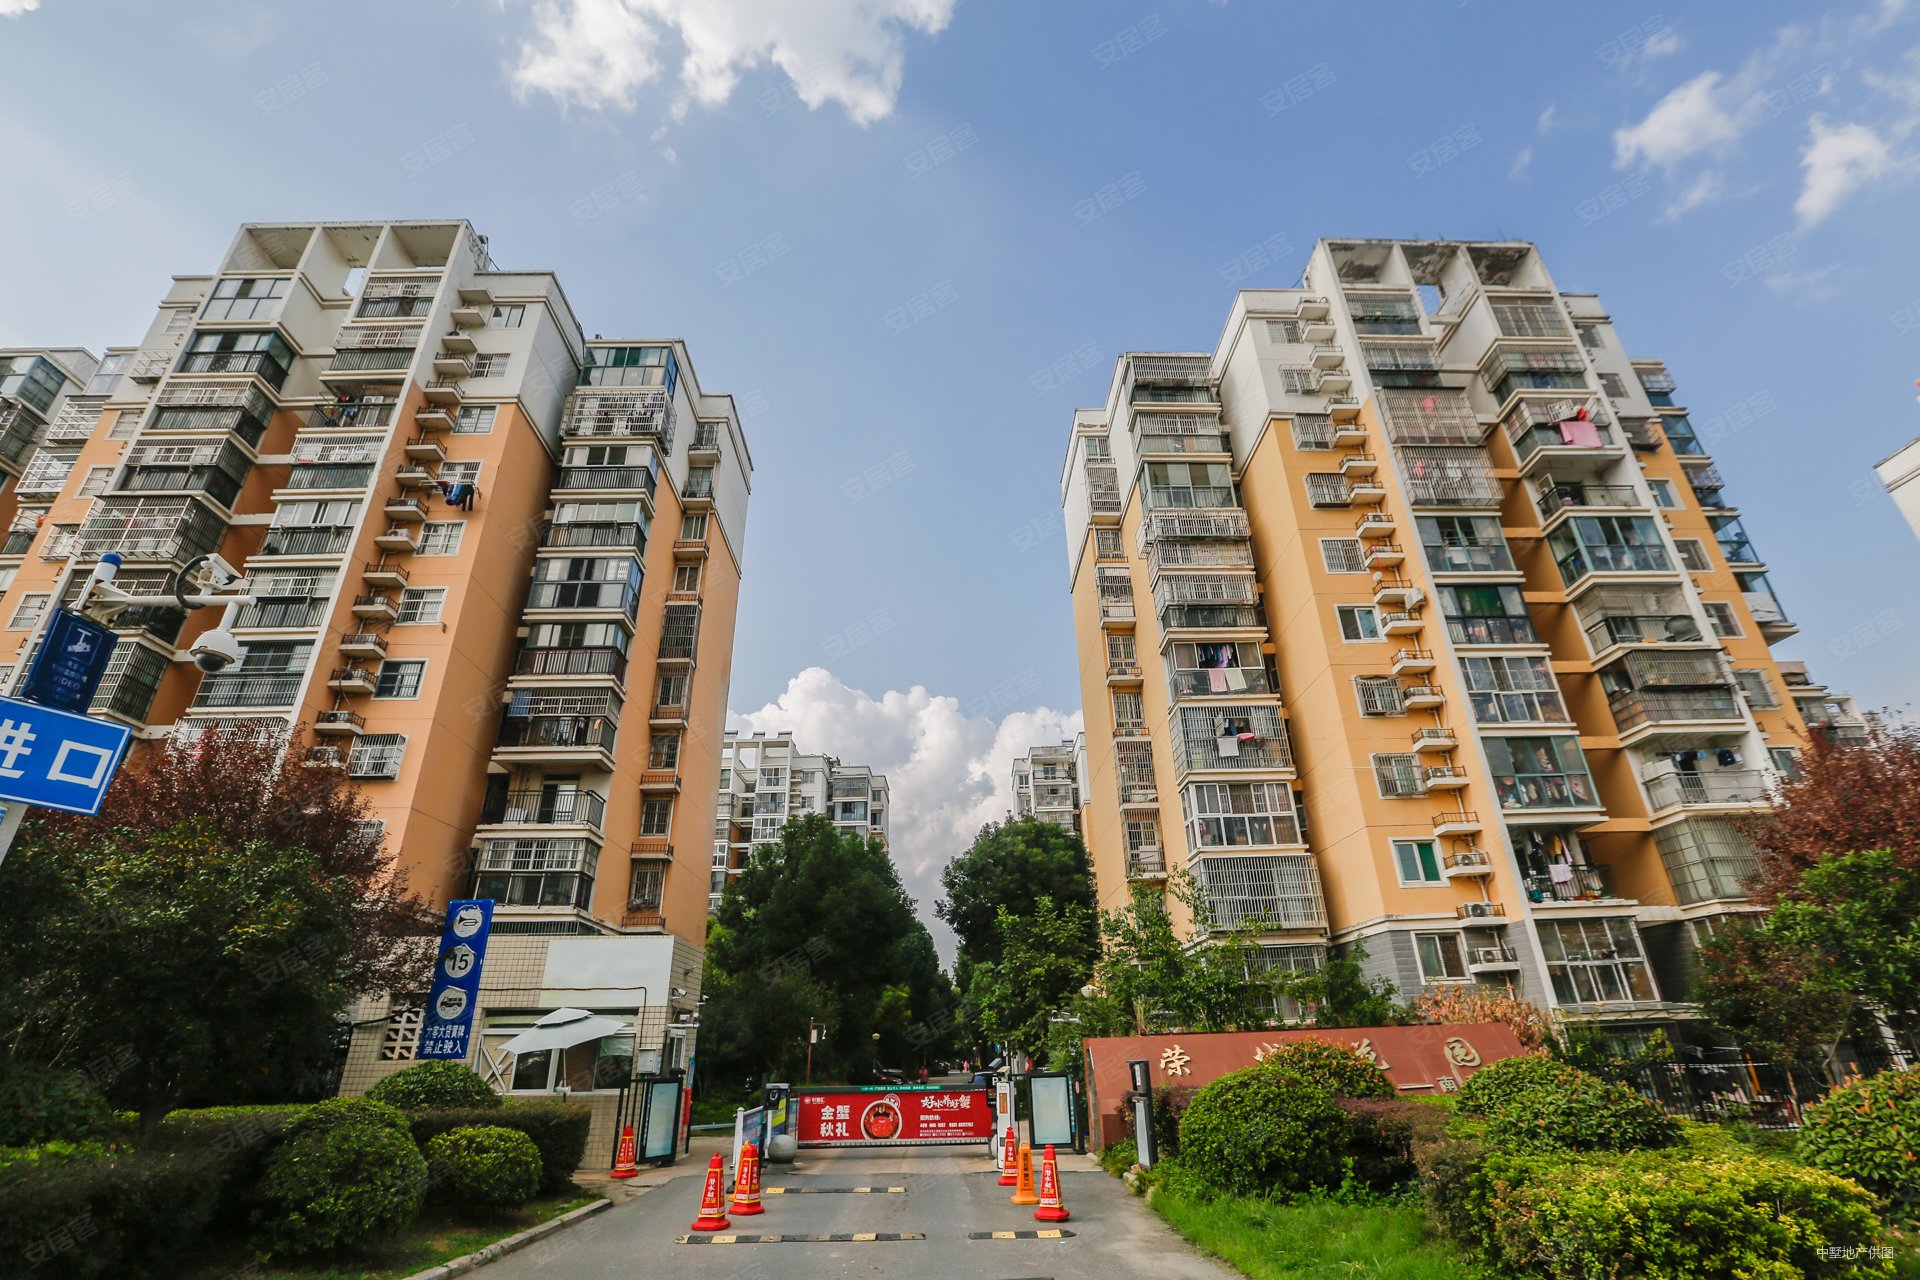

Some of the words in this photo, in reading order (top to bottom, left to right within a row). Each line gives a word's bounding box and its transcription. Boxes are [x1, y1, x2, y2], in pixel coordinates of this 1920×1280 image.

[451, 953, 469, 971] 15
[423, 1040, 462, 1055] 禁止驶入
[920, 1094, 971, 1109] 好水养好蟹
[821, 1105, 850, 1120] 金蟹
[820, 1121, 850, 1137] 秋礼
[1044, 1169, 1052, 1188] 潜水艇
[707, 1178, 716, 1198] 潜水艇
